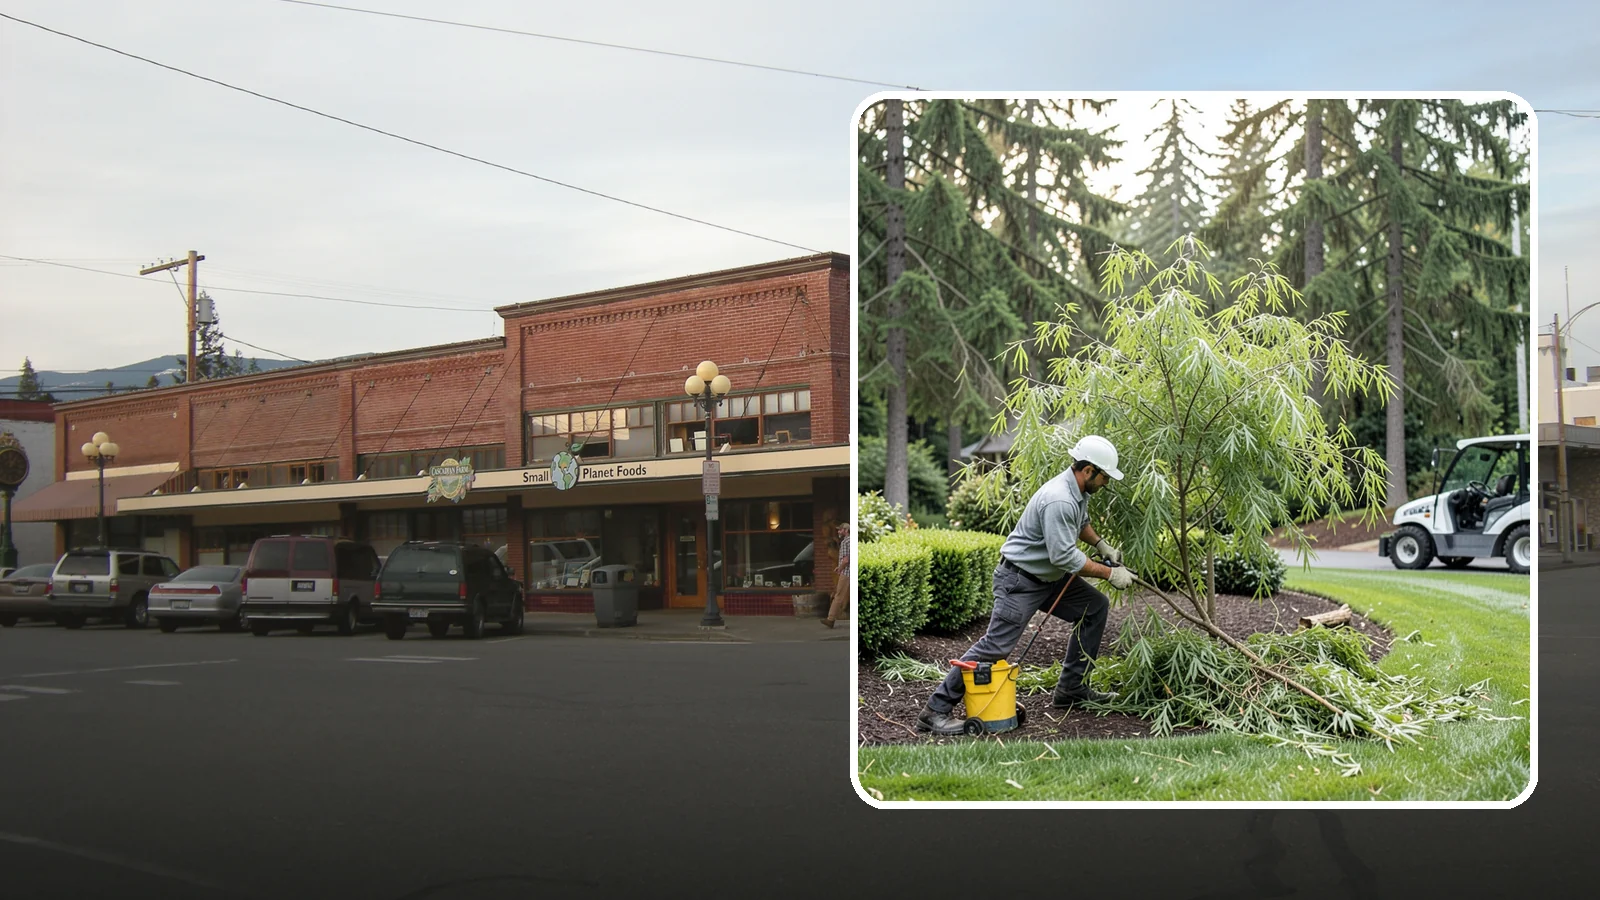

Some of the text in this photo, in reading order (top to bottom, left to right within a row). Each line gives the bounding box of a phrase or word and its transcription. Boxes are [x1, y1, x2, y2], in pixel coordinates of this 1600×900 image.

[523, 464, 647, 483] Small Planet Foods
